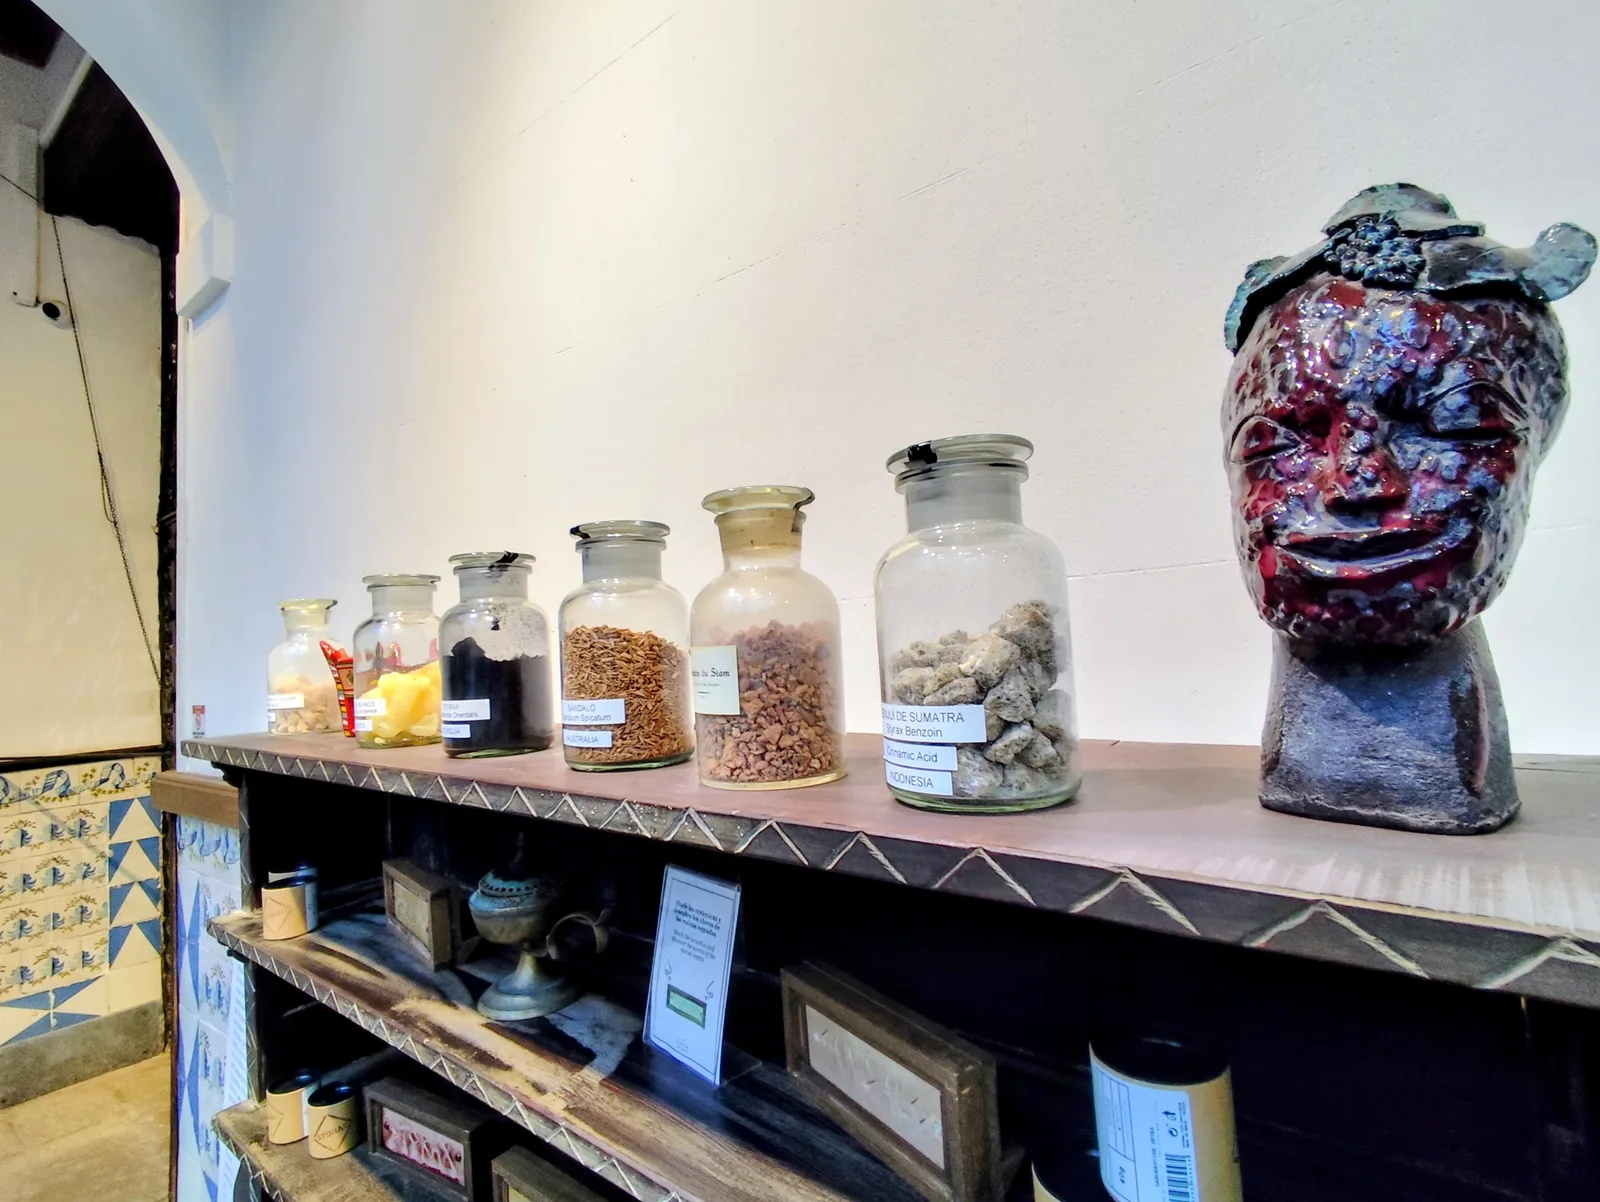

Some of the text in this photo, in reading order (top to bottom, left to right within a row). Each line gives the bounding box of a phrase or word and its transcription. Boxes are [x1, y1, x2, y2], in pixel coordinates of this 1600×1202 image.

[710, 667, 730, 677] Siam
[580, 713, 612, 723] Spicatum
[896, 710, 908, 722] DE
[909, 711, 965, 723] SUMATRA
[905, 725, 943, 738] Benzoin
[566, 734, 599, 744] AUSTRALIA
[916, 751, 938, 763] Acid
[889, 771, 935, 788] NDONESIA
